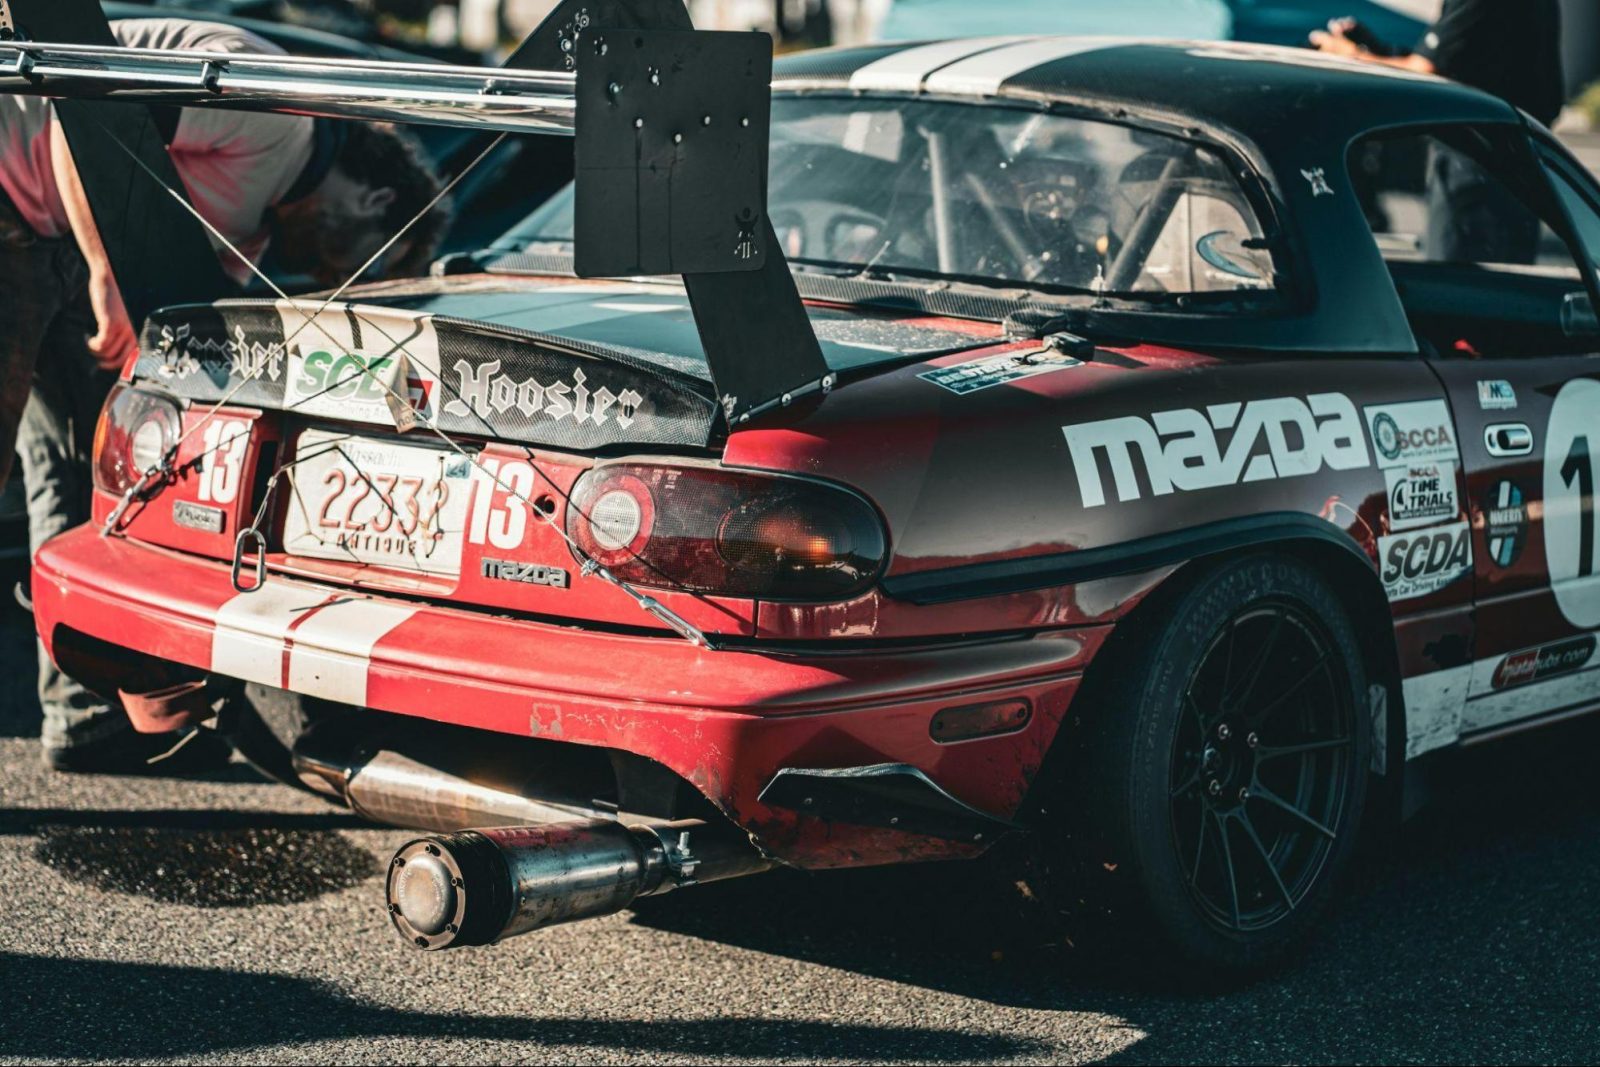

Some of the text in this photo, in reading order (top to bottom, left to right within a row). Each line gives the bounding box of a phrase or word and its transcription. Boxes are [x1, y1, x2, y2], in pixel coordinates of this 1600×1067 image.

[443, 358, 644, 430] Hoosier
[197, 419, 248, 505] 13
[468, 458, 535, 550] 13
[1383, 529, 1470, 583] SCDA
